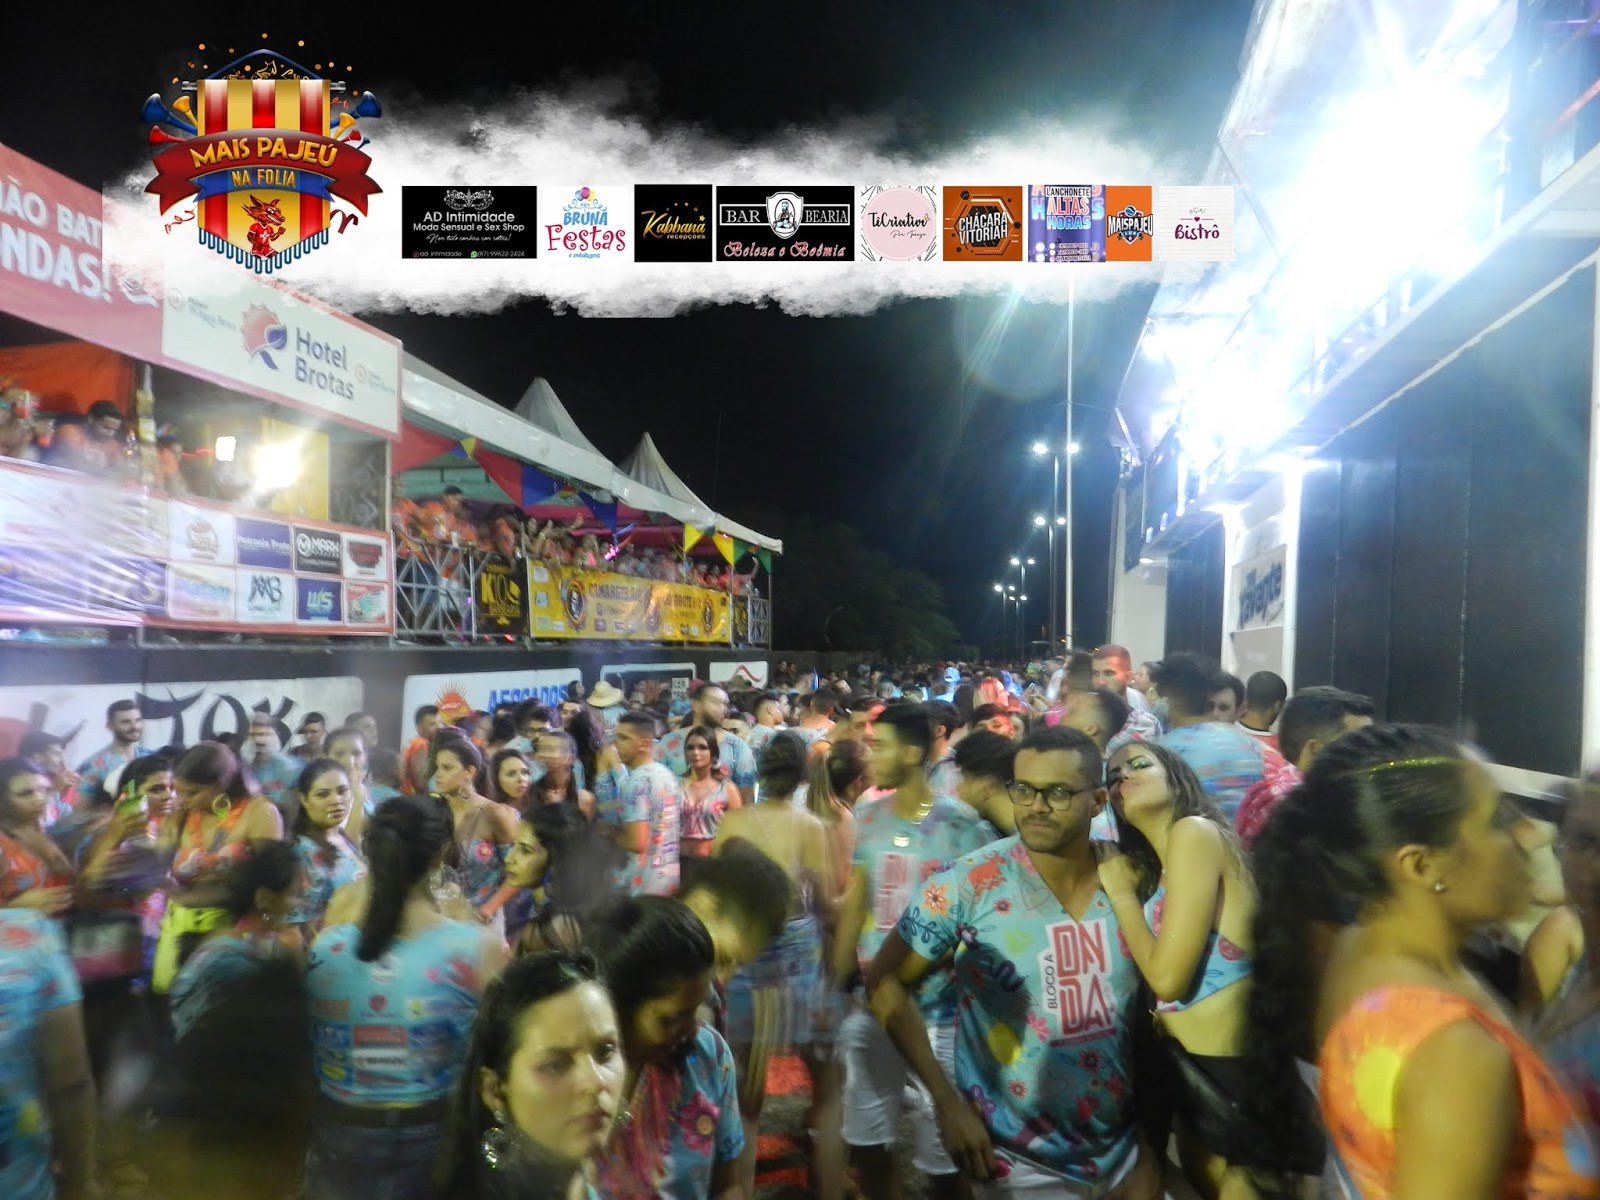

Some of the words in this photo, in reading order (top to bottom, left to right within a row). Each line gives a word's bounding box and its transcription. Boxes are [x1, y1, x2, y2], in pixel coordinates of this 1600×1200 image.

[296, 326, 347, 371] Hotel
[295, 354, 354, 401] Brotas
[1043, 953, 1054, 963] A
[1044, 966, 1058, 1010] BLOCO
